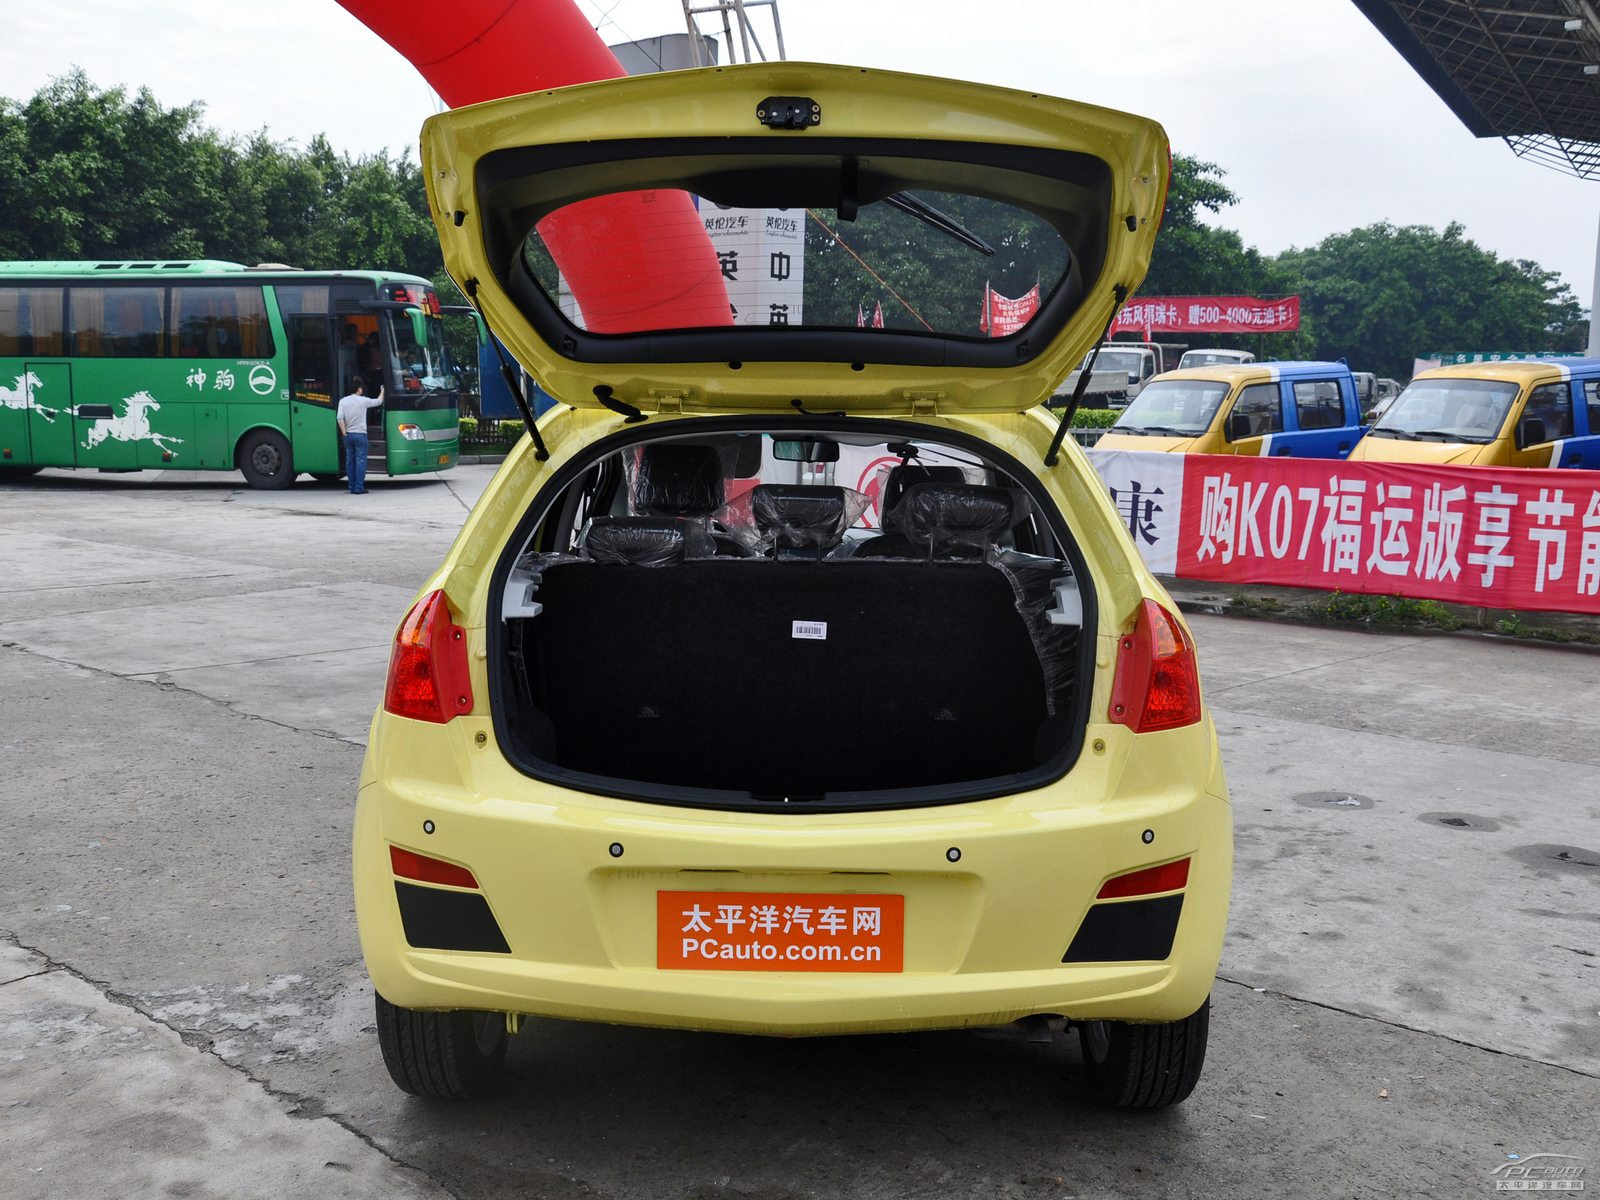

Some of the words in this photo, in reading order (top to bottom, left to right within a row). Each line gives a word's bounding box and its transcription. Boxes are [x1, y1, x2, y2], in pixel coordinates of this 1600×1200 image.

[704, 215, 749, 230] 英伦汽车
[766, 215, 798, 232] 英伦汽车
[185, 367, 235, 392] 神驹
[1109, 480, 1165, 546] 康
[681, 904, 881, 936] 太平洋汽车网
[681, 938, 881, 961] PCauto.com.cn
